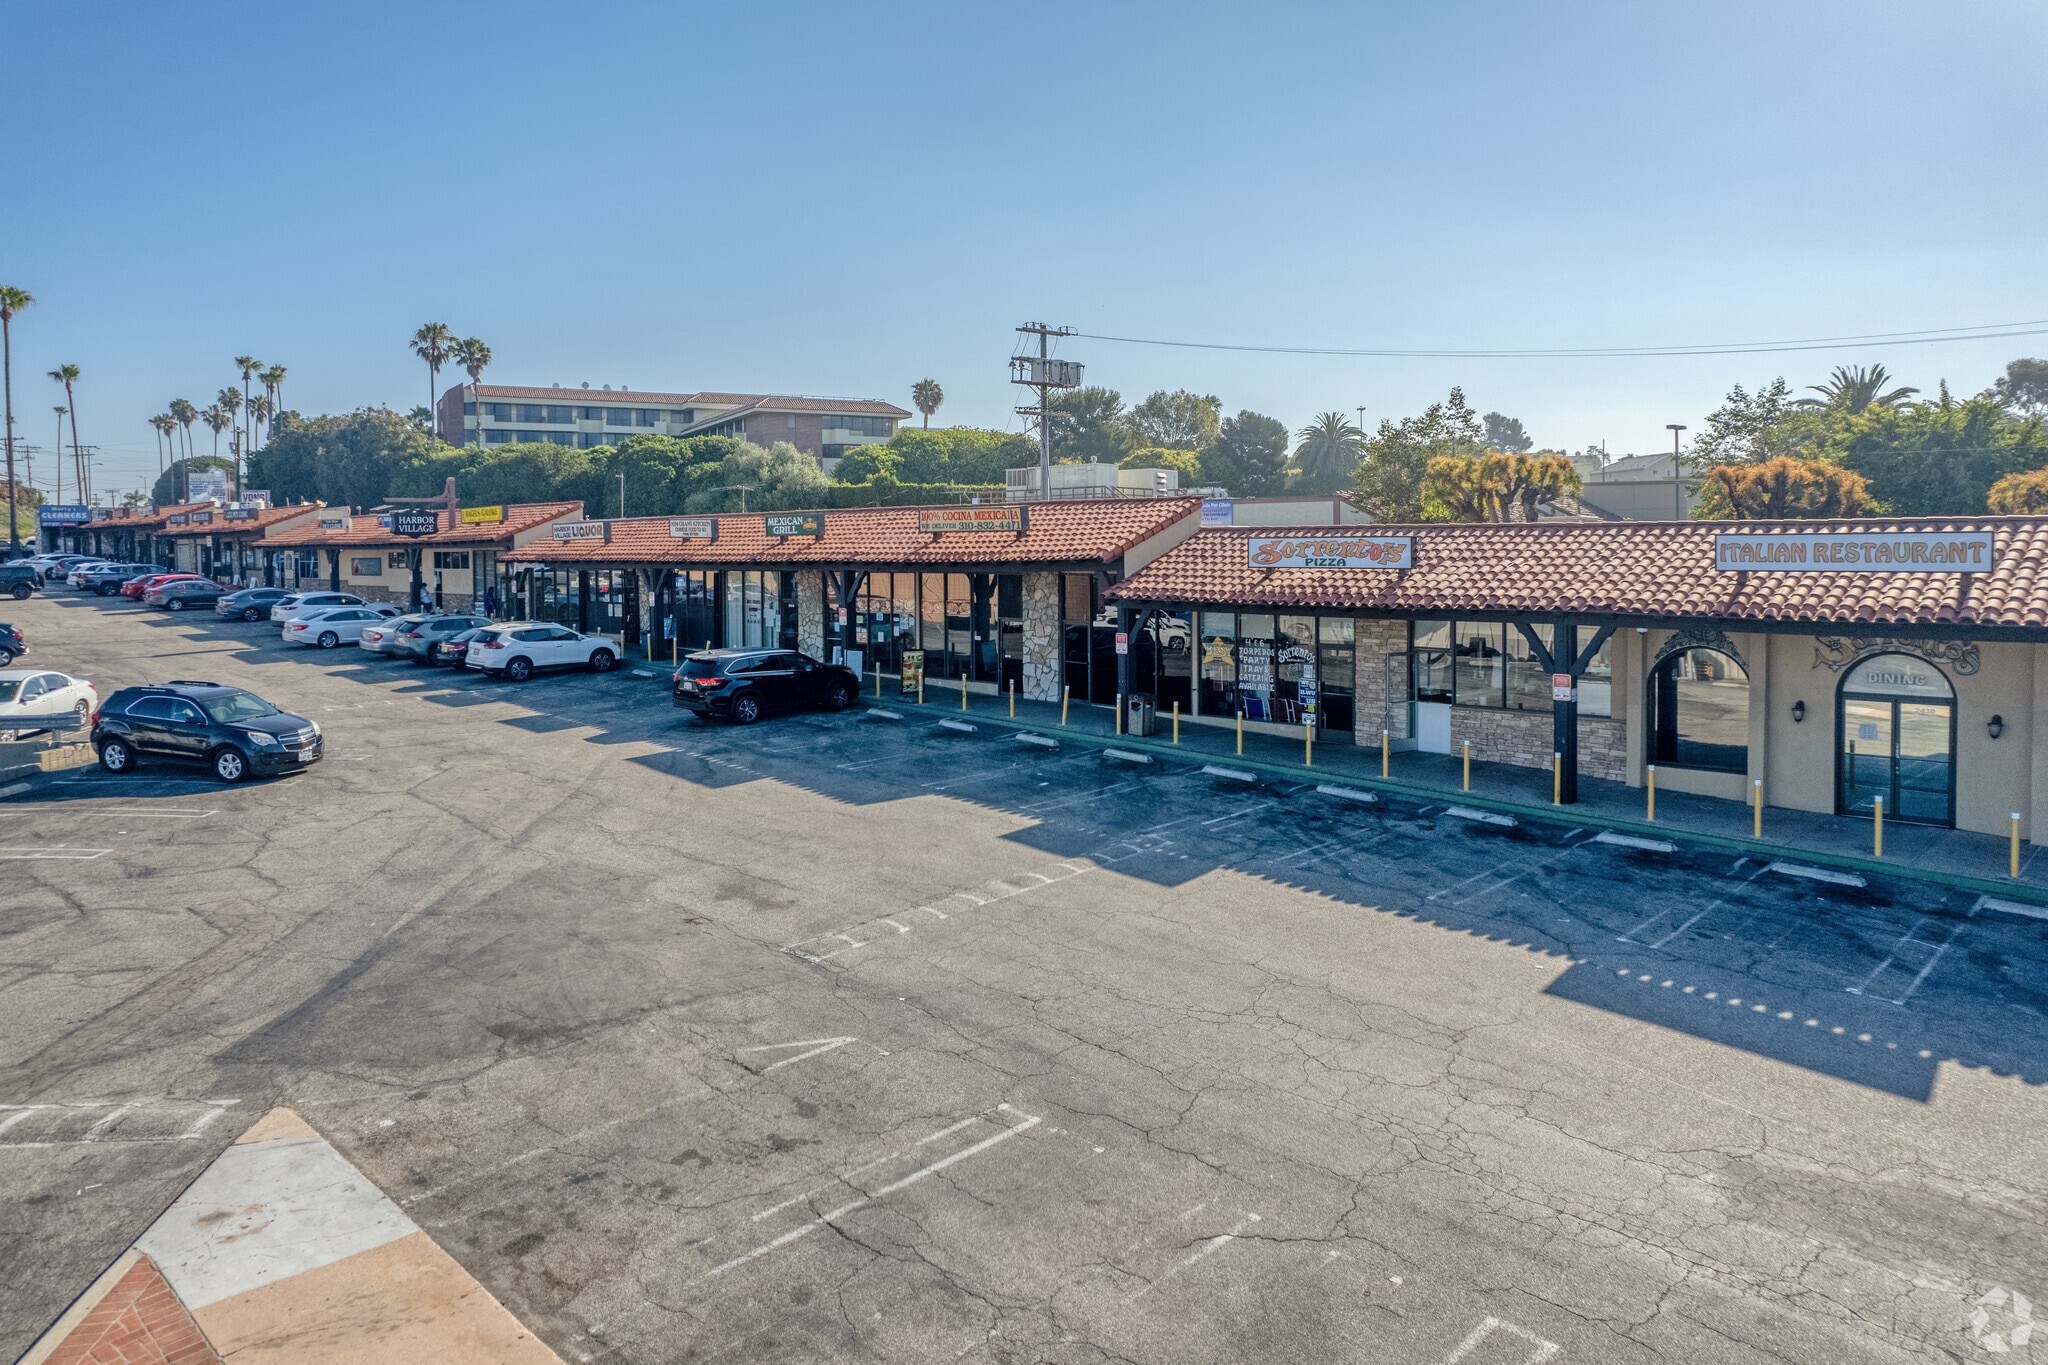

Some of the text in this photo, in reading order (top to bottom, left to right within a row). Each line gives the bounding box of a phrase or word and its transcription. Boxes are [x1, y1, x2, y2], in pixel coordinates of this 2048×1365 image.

[243, 493, 265, 502] VONS
[398, 516, 435, 525] HARBOR
[767, 516, 804, 526] MEXICAN
[921, 511, 941, 522] 100%
[942, 511, 973, 521] COCINA
[399, 524, 434, 533] VILLAGE
[571, 524, 603, 538] LIQUOR
[773, 525, 798, 535] GRILL
[958, 521, 1020, 531] 310-832-4471
[1720, 541, 1987, 564] ITALIAN RESTAURANT
[1305, 557, 1346, 567] PIZZA
[1238, 647, 1275, 656] TORPEDOS
[1243, 656, 1271, 664] PARTY
[1243, 665, 1269, 673] TRAYS
[1238, 674, 1275, 682] CATERING
[1868, 672, 1926, 686] DINING
[1238, 682, 1275, 692] AVAILABLE
